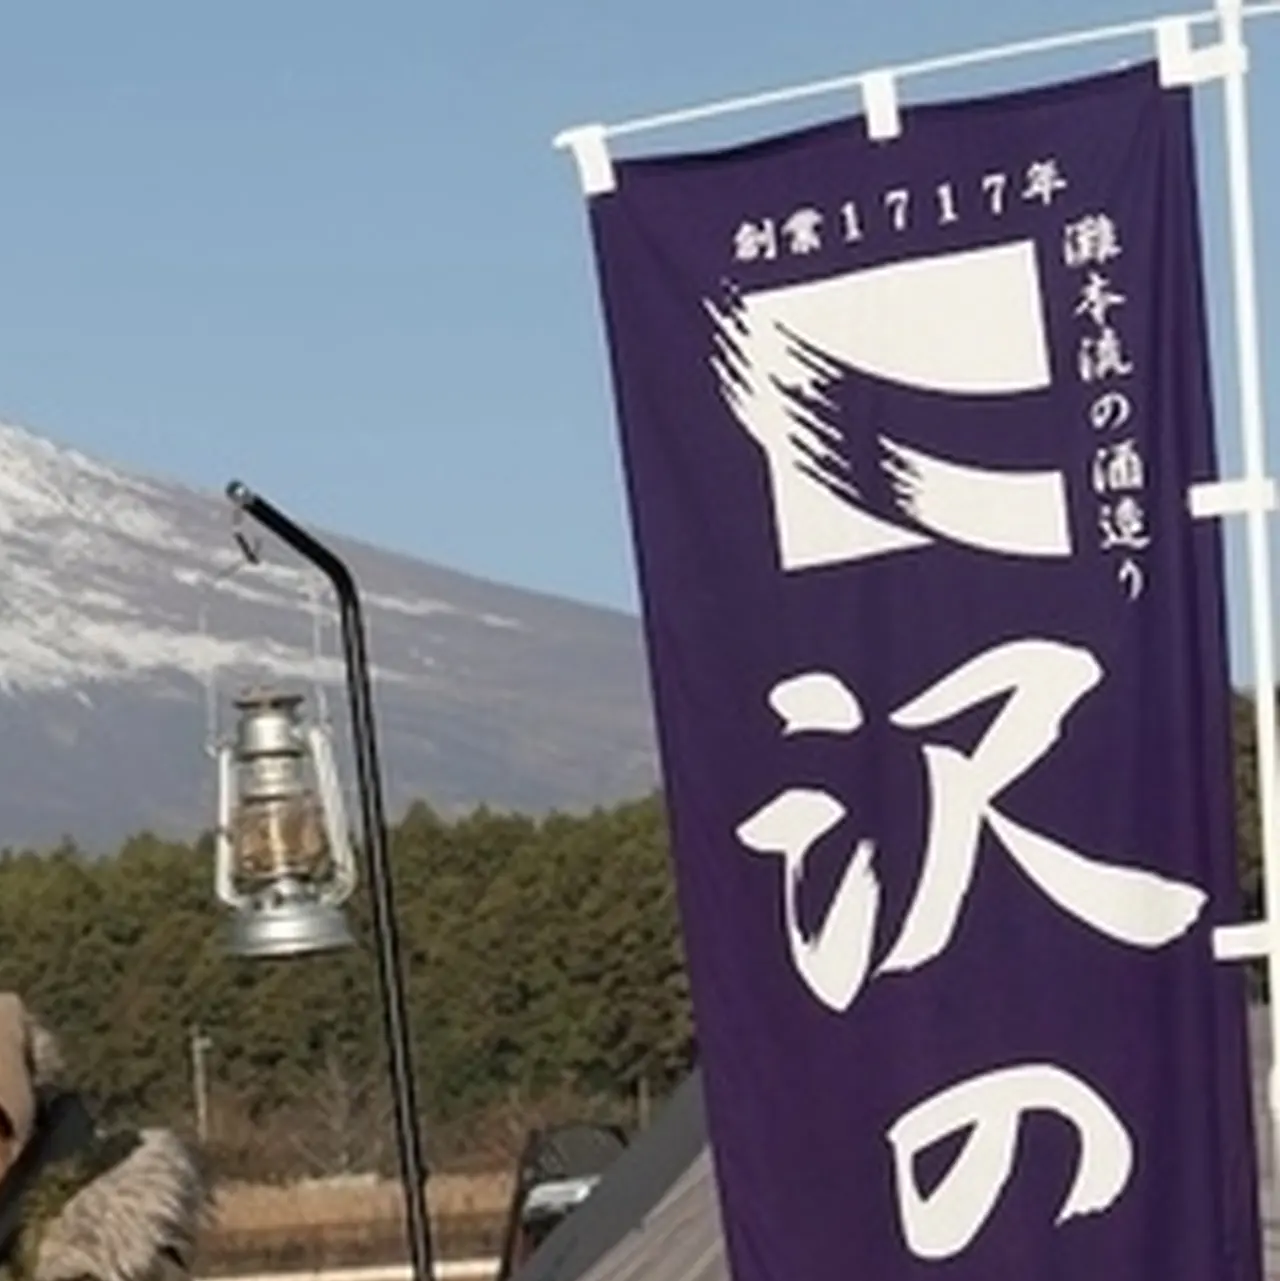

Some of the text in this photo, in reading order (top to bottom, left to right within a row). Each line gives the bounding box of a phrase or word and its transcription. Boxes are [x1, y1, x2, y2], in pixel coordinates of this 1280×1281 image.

[733, 157, 1068, 260] 創業1717年
[1063, 213, 1150, 601] 灘本流の酒造り
